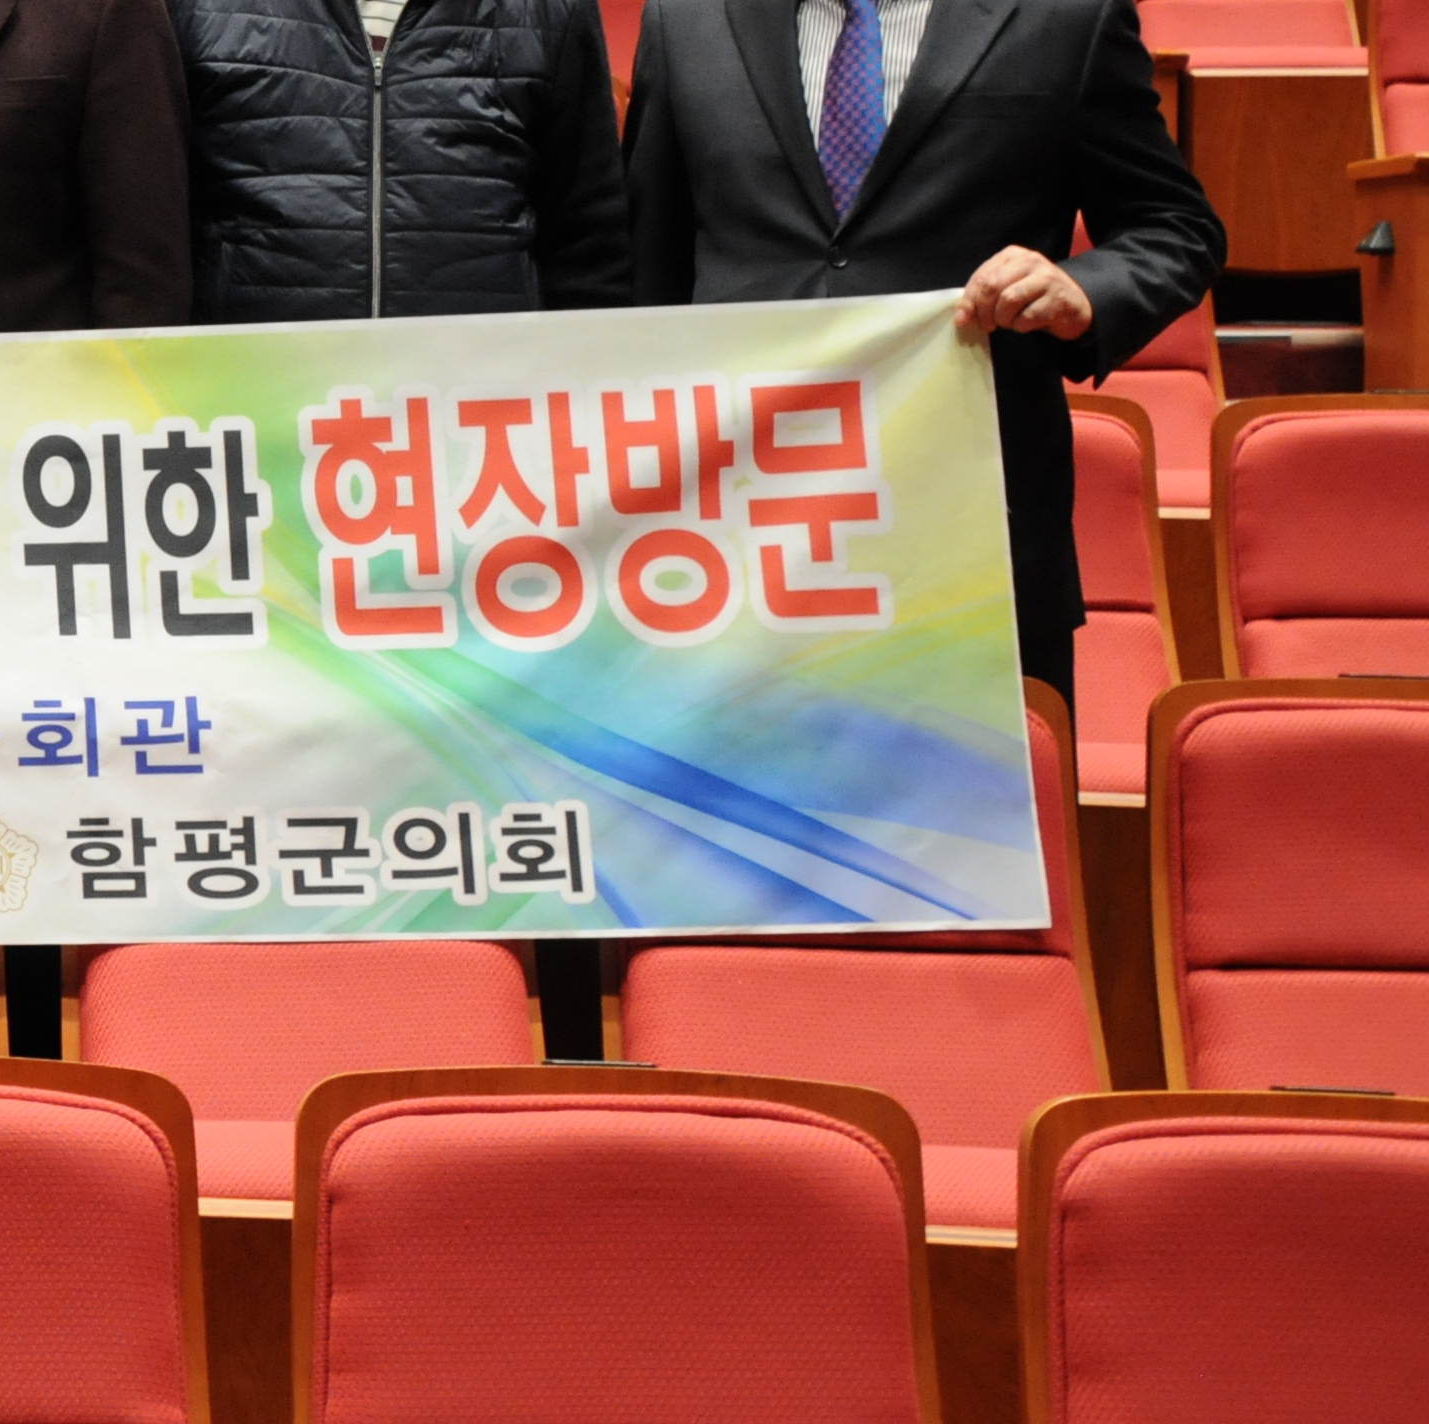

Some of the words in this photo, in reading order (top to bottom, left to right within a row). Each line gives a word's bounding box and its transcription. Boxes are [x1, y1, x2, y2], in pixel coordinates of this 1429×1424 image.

[21, 429, 260, 639] 위한
[311, 379, 881, 640] 현장방문
[65, 807, 587, 900] 함평군의회
